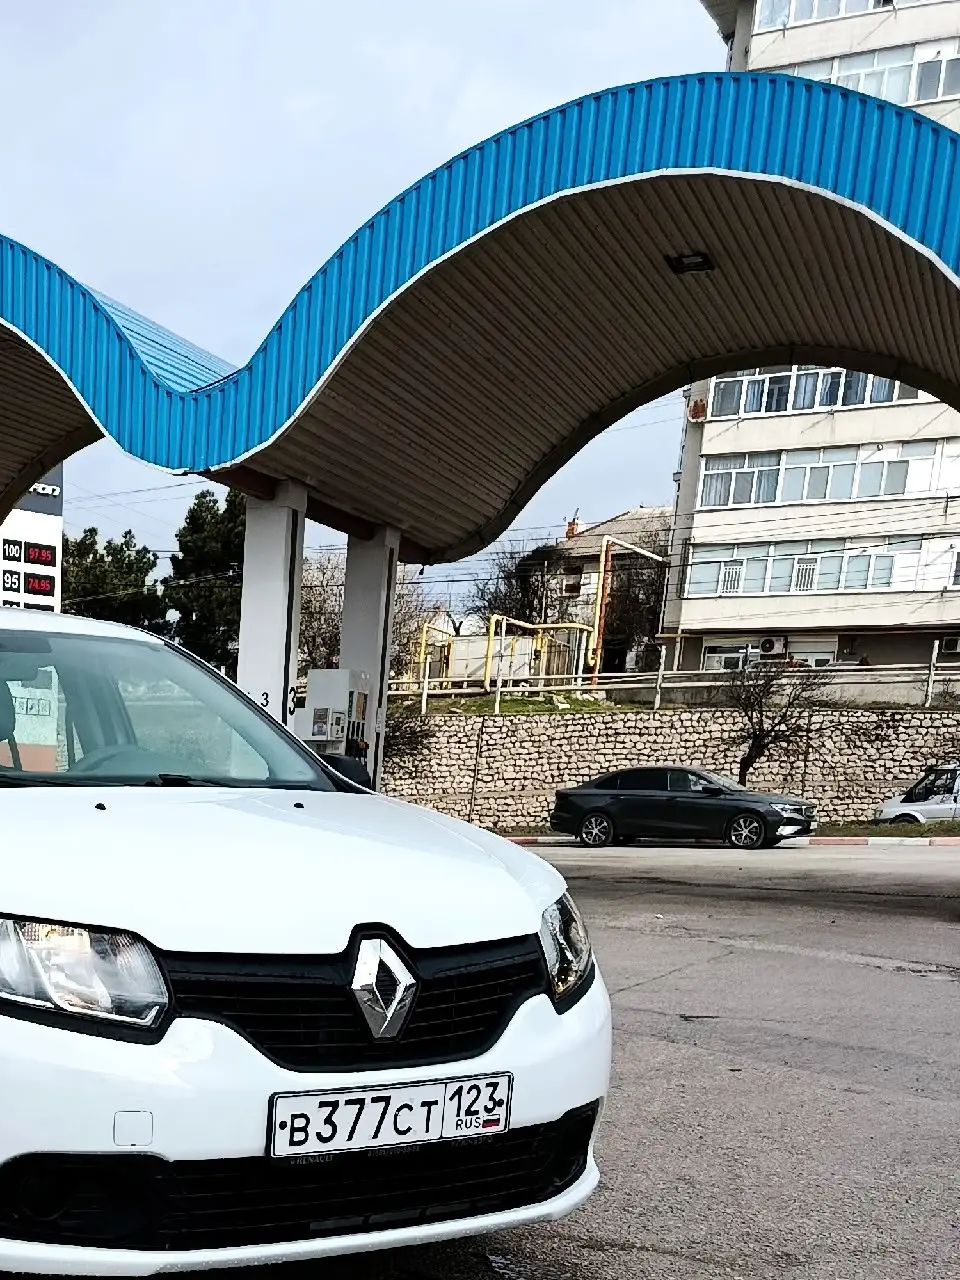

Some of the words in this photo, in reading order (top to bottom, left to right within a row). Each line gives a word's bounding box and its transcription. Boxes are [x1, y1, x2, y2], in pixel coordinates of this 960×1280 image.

[4, 544, 20, 557] 100
[29, 548, 51, 561] 97.95
[4, 573, 18, 588] 95
[28, 578, 50, 590] 74.95
[261, 692, 269, 707] 3
[289, 687, 296, 715] 3
[449, 1081, 500, 1118] 123
[455, 1116, 481, 1131] RUS
